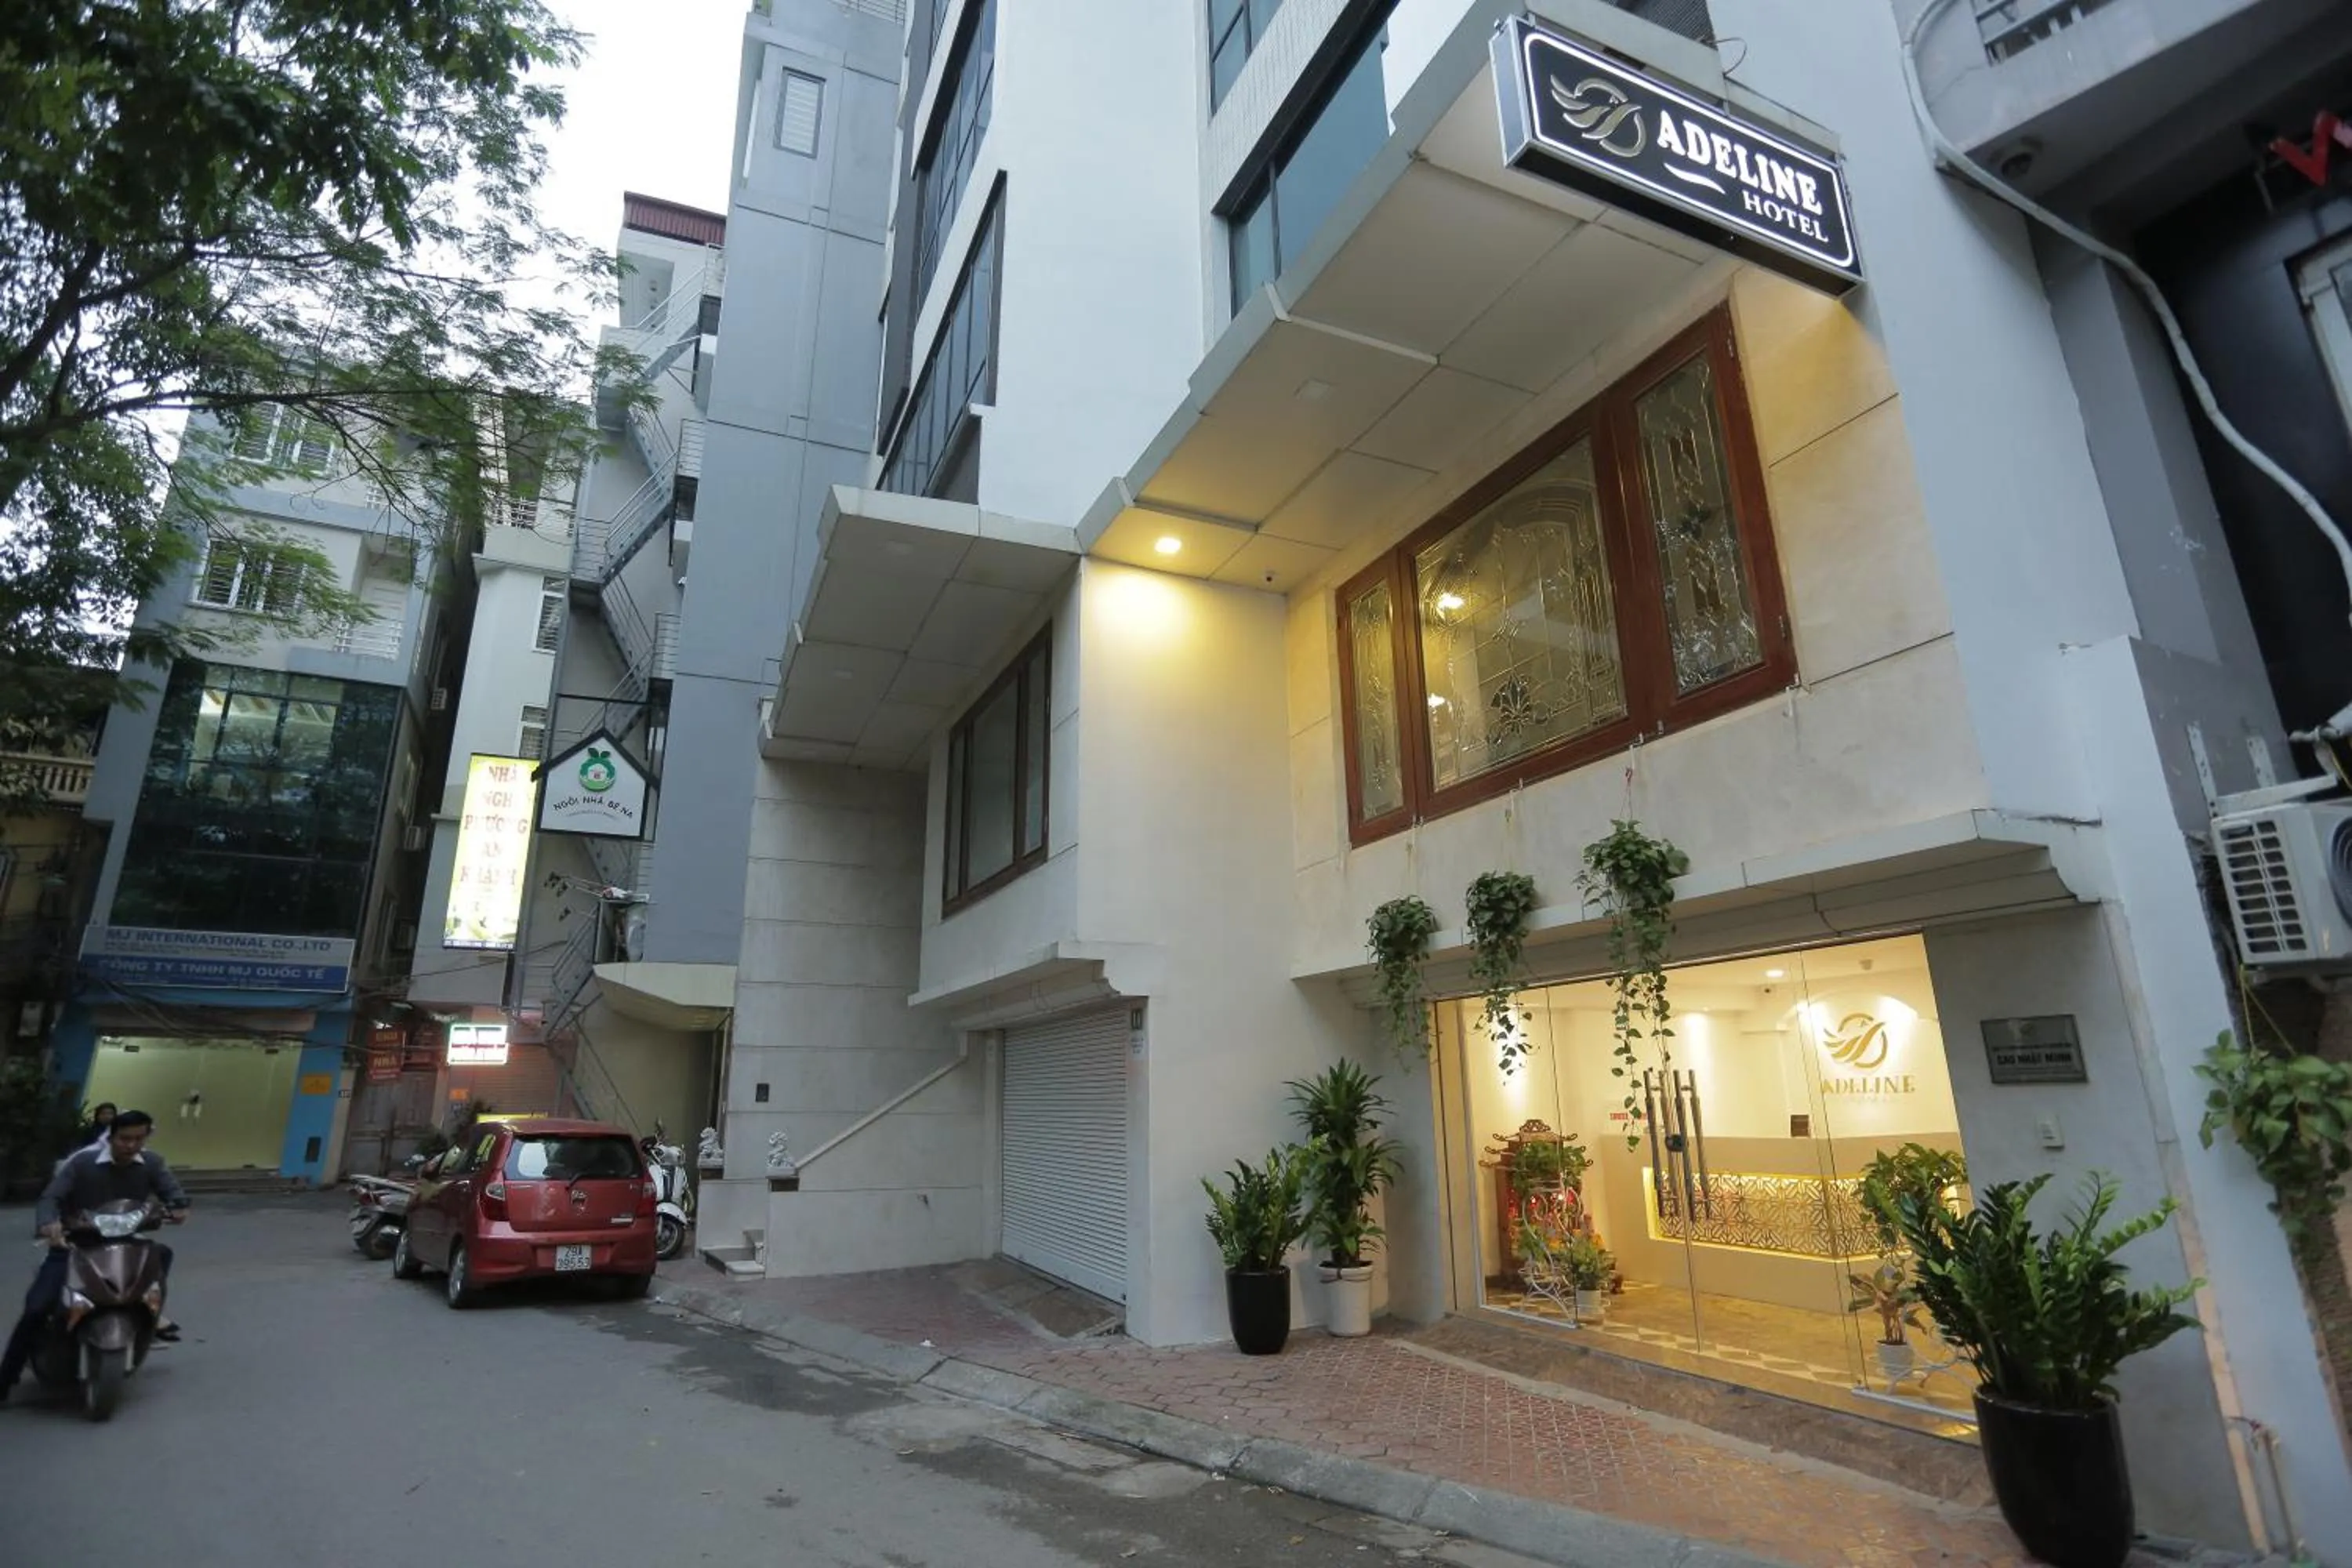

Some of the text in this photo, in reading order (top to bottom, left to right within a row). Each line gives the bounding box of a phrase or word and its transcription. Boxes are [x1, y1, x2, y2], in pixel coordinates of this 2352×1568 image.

[1657, 110, 1823, 216] ADELINE
[1743, 190, 1829, 242] HOTEL
[106, 928, 130, 941] MJ
[136, 930, 267, 948] INTERNATIONAL
[154, 962, 176, 972] TY
[180, 963, 224, 975] TNHH
[256, 964, 302, 978] QUỐC
[1822, 1075, 1915, 1094] ADELINE
